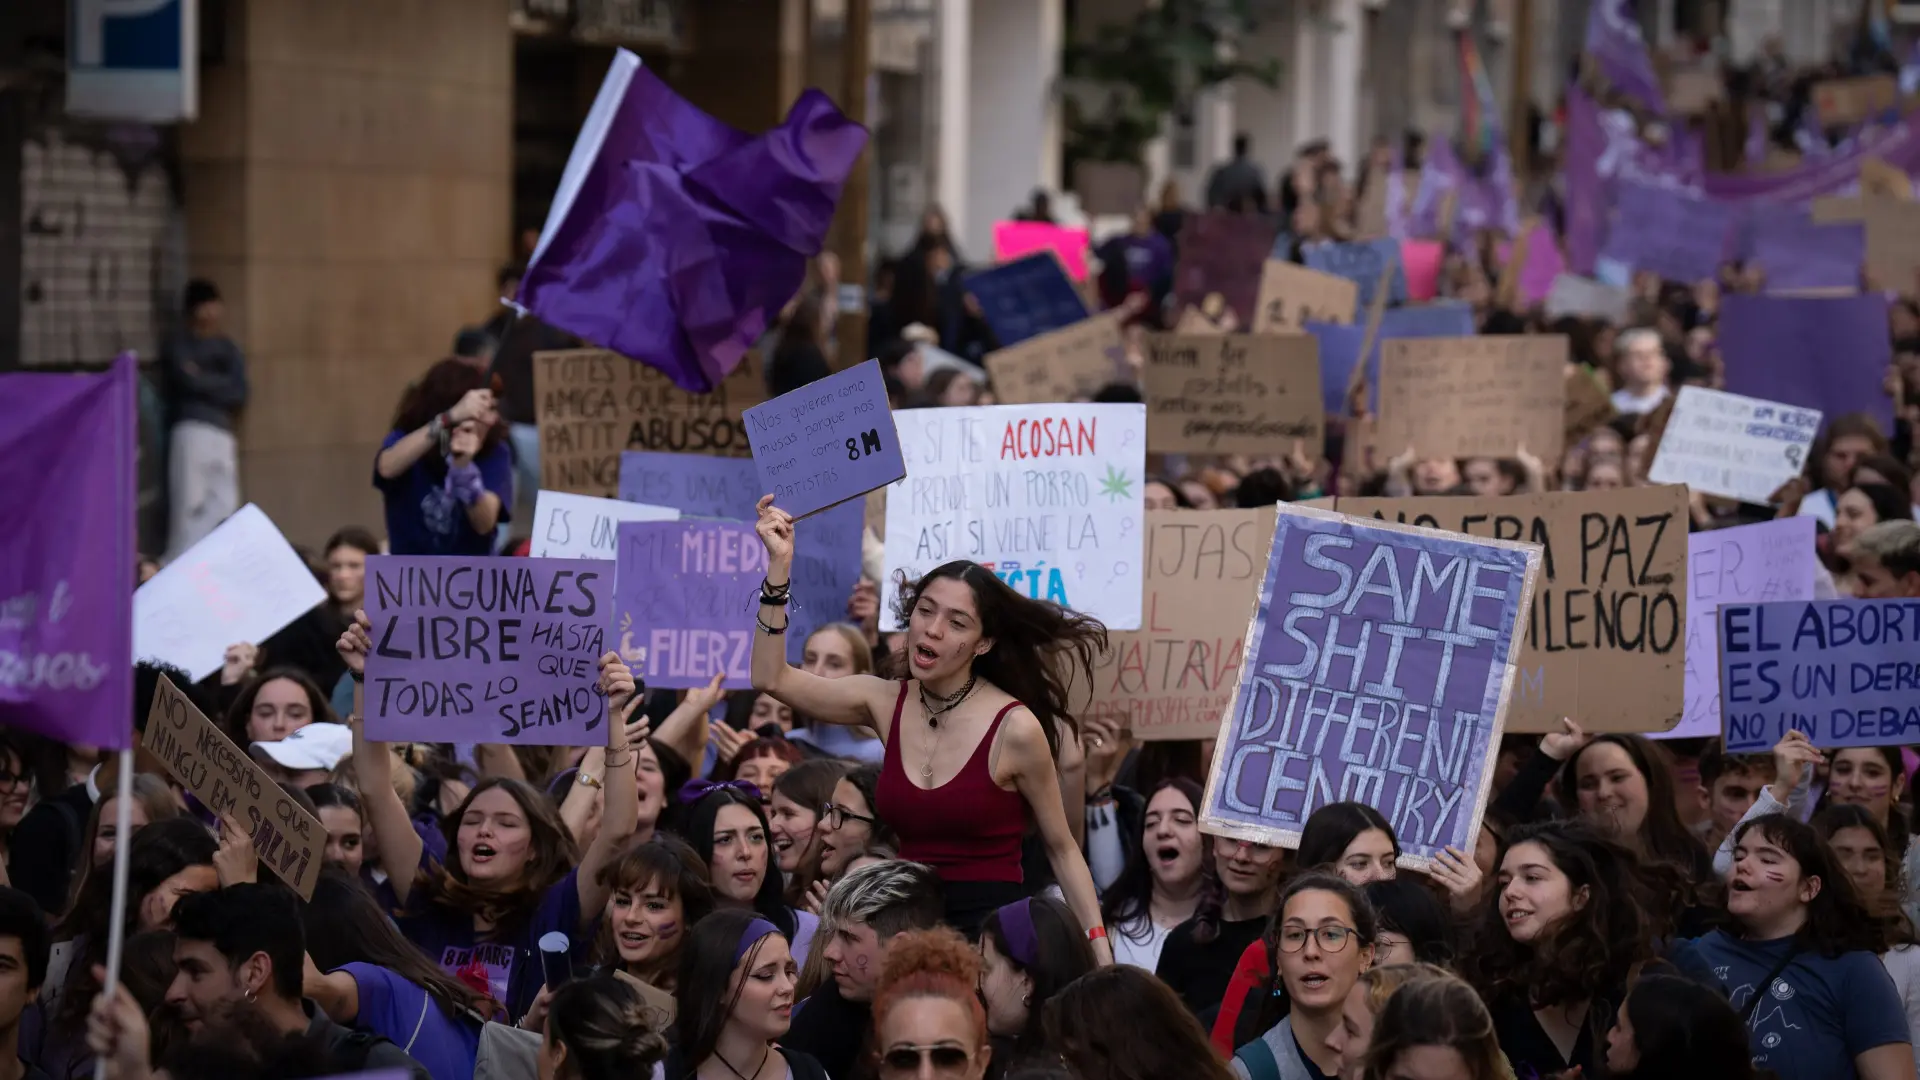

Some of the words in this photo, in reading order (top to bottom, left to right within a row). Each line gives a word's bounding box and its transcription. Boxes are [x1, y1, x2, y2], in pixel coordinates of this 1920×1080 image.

[541, 357, 616, 384] TOTES
[629, 358, 668, 384] TE
[544, 388, 620, 419] AMIGA
[626, 386, 677, 417] QUE
[751, 411, 781, 433] Nos
[790, 394, 835, 424] quieren
[838, 380, 866, 398] como
[545, 422, 621, 453] PATIT
[628, 418, 750, 450] ABUSOS
[760, 432, 798, 457] musas
[805, 410, 845, 442] porque
[854, 399, 875, 415] nos
[811, 439, 841, 457] como
[846, 428, 882, 460] 8M
[924, 419, 944, 465] SI
[957, 418, 984, 463] TE
[1001, 417, 1097, 461] ACOSAN
[911, 473, 972, 516] PRENDE
[985, 471, 1010, 509] UN
[1023, 469, 1090, 508] PORRO
[546, 507, 572, 546] ES
[916, 520, 952, 560] ASÍ
[968, 518, 985, 556] SI
[993, 514, 1054, 553] VIENE
[1066, 513, 1100, 551] LA
[1580, 512, 1674, 587] PAZ
[628, 532, 665, 573] MI
[376, 567, 540, 614] NINGUNA
[544, 570, 598, 617] ES
[1289, 532, 1512, 640] SAME
[376, 616, 522, 664] LIBRE
[531, 621, 604, 658] HASTA
[1524, 588, 1679, 653] ILENCIO
[1725, 605, 1781, 651] EL
[1793, 602, 1920, 651] ABORT
[538, 654, 590, 679] QUE
[1263, 607, 1478, 708] SHIT
[375, 677, 474, 717] TODAS
[485, 676, 518, 702] LO
[1729, 660, 1781, 704] ES
[1792, 663, 1836, 699] UN
[157, 684, 187, 730] NO
[499, 682, 605, 737] SEAMOS
[1240, 675, 1480, 786] DIFFERENT
[1728, 712, 1766, 742] NO
[1778, 712, 1817, 741] UN
[210, 778, 237, 817] EM
[1223, 744, 1466, 848] CENTURY
[444, 949, 456, 967] 8
